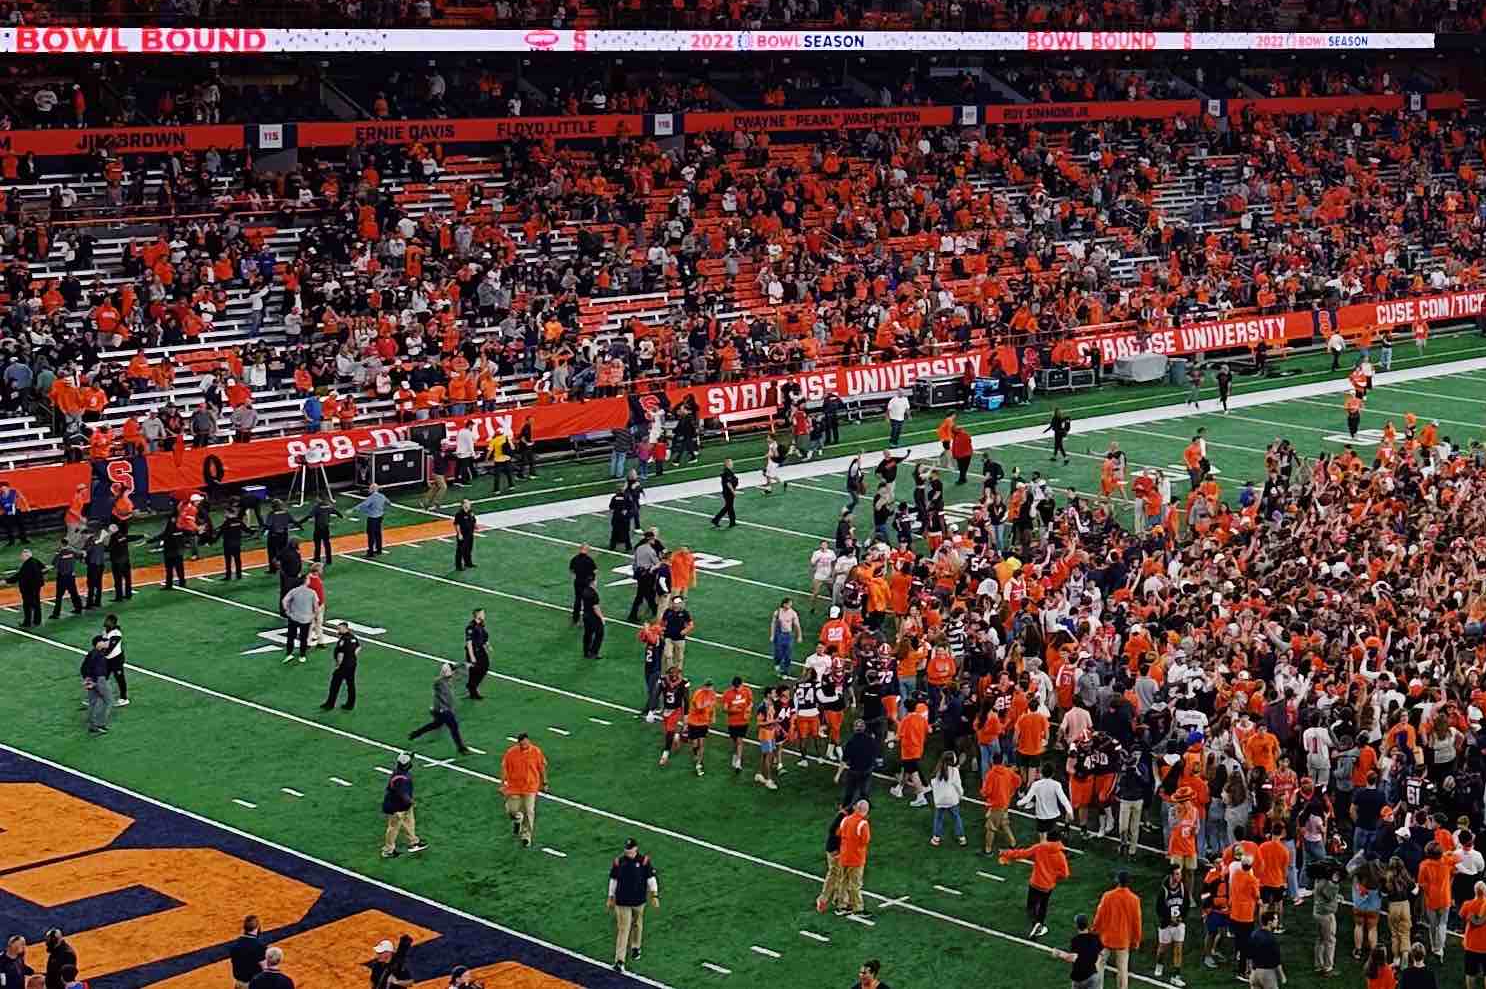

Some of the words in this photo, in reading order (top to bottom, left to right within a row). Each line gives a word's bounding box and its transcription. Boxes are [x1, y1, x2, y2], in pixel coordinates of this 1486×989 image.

[16, 29, 127, 52] BOWL
[142, 29, 267, 52] BOUND
[691, 34, 734, 49] 2022
[757, 34, 801, 49] BOWL
[803, 34, 864, 49] SEASON
[1027, 32, 1083, 50] BOWL
[1092, 32, 1156, 50] BOUND
[1256, 36, 1284, 48] 2022
[1328, 35, 1368, 48] SEASON
[355, 124, 404, 140] ERNIE
[409, 123, 456, 139] DAVIS
[1181, 317, 1286, 350] UNIVERSITY
[665, 692, 676, 705] 3
[796, 687, 814, 704] 24
[1406, 787, 1422, 805] 61
